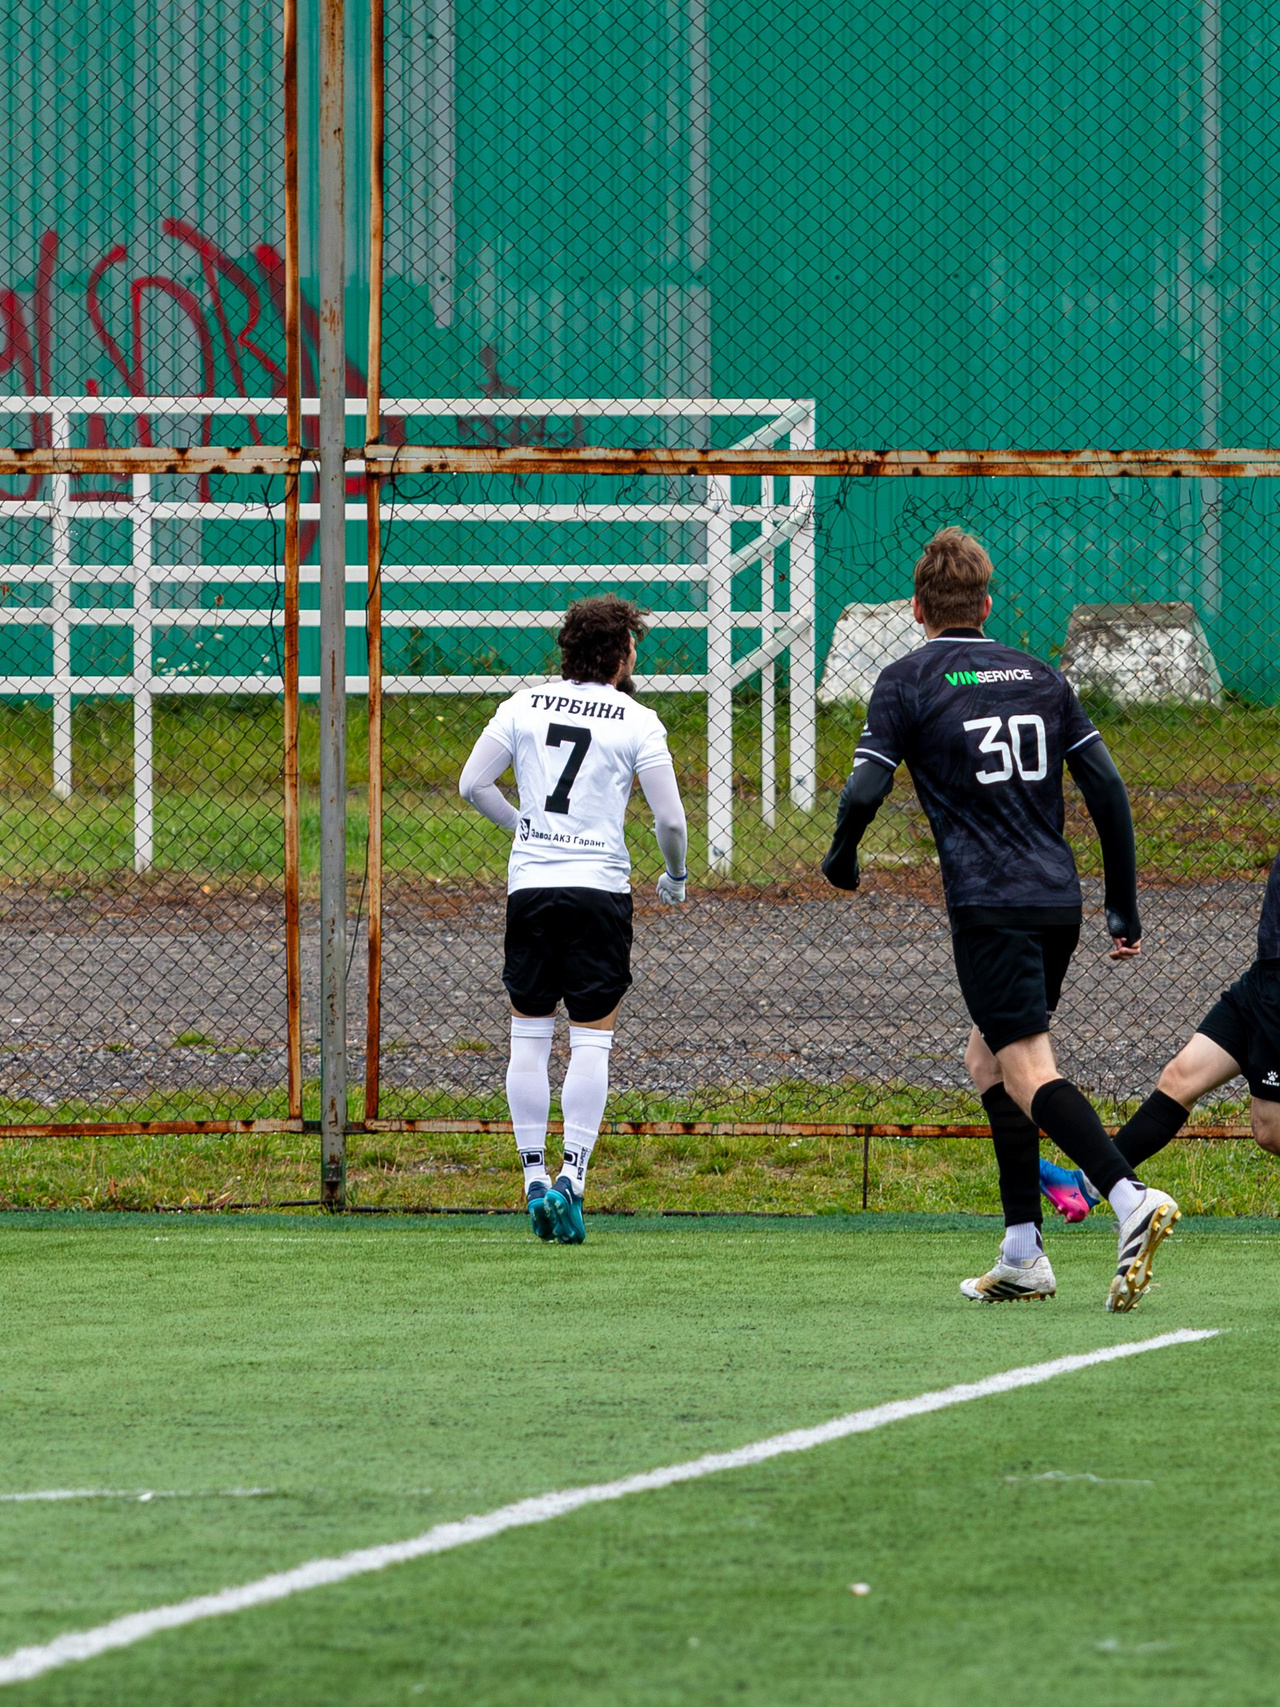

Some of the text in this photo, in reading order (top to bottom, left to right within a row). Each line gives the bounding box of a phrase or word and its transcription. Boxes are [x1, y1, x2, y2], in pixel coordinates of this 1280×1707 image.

[944, 668, 1033, 687] VINSERVICE
[531, 694, 625, 720] ТУРБИНА
[962, 714, 1048, 785] 30
[544, 722, 592, 815] 7
[552, 833, 571, 844] АКЗ
[573, 836, 606, 848] Гарант
